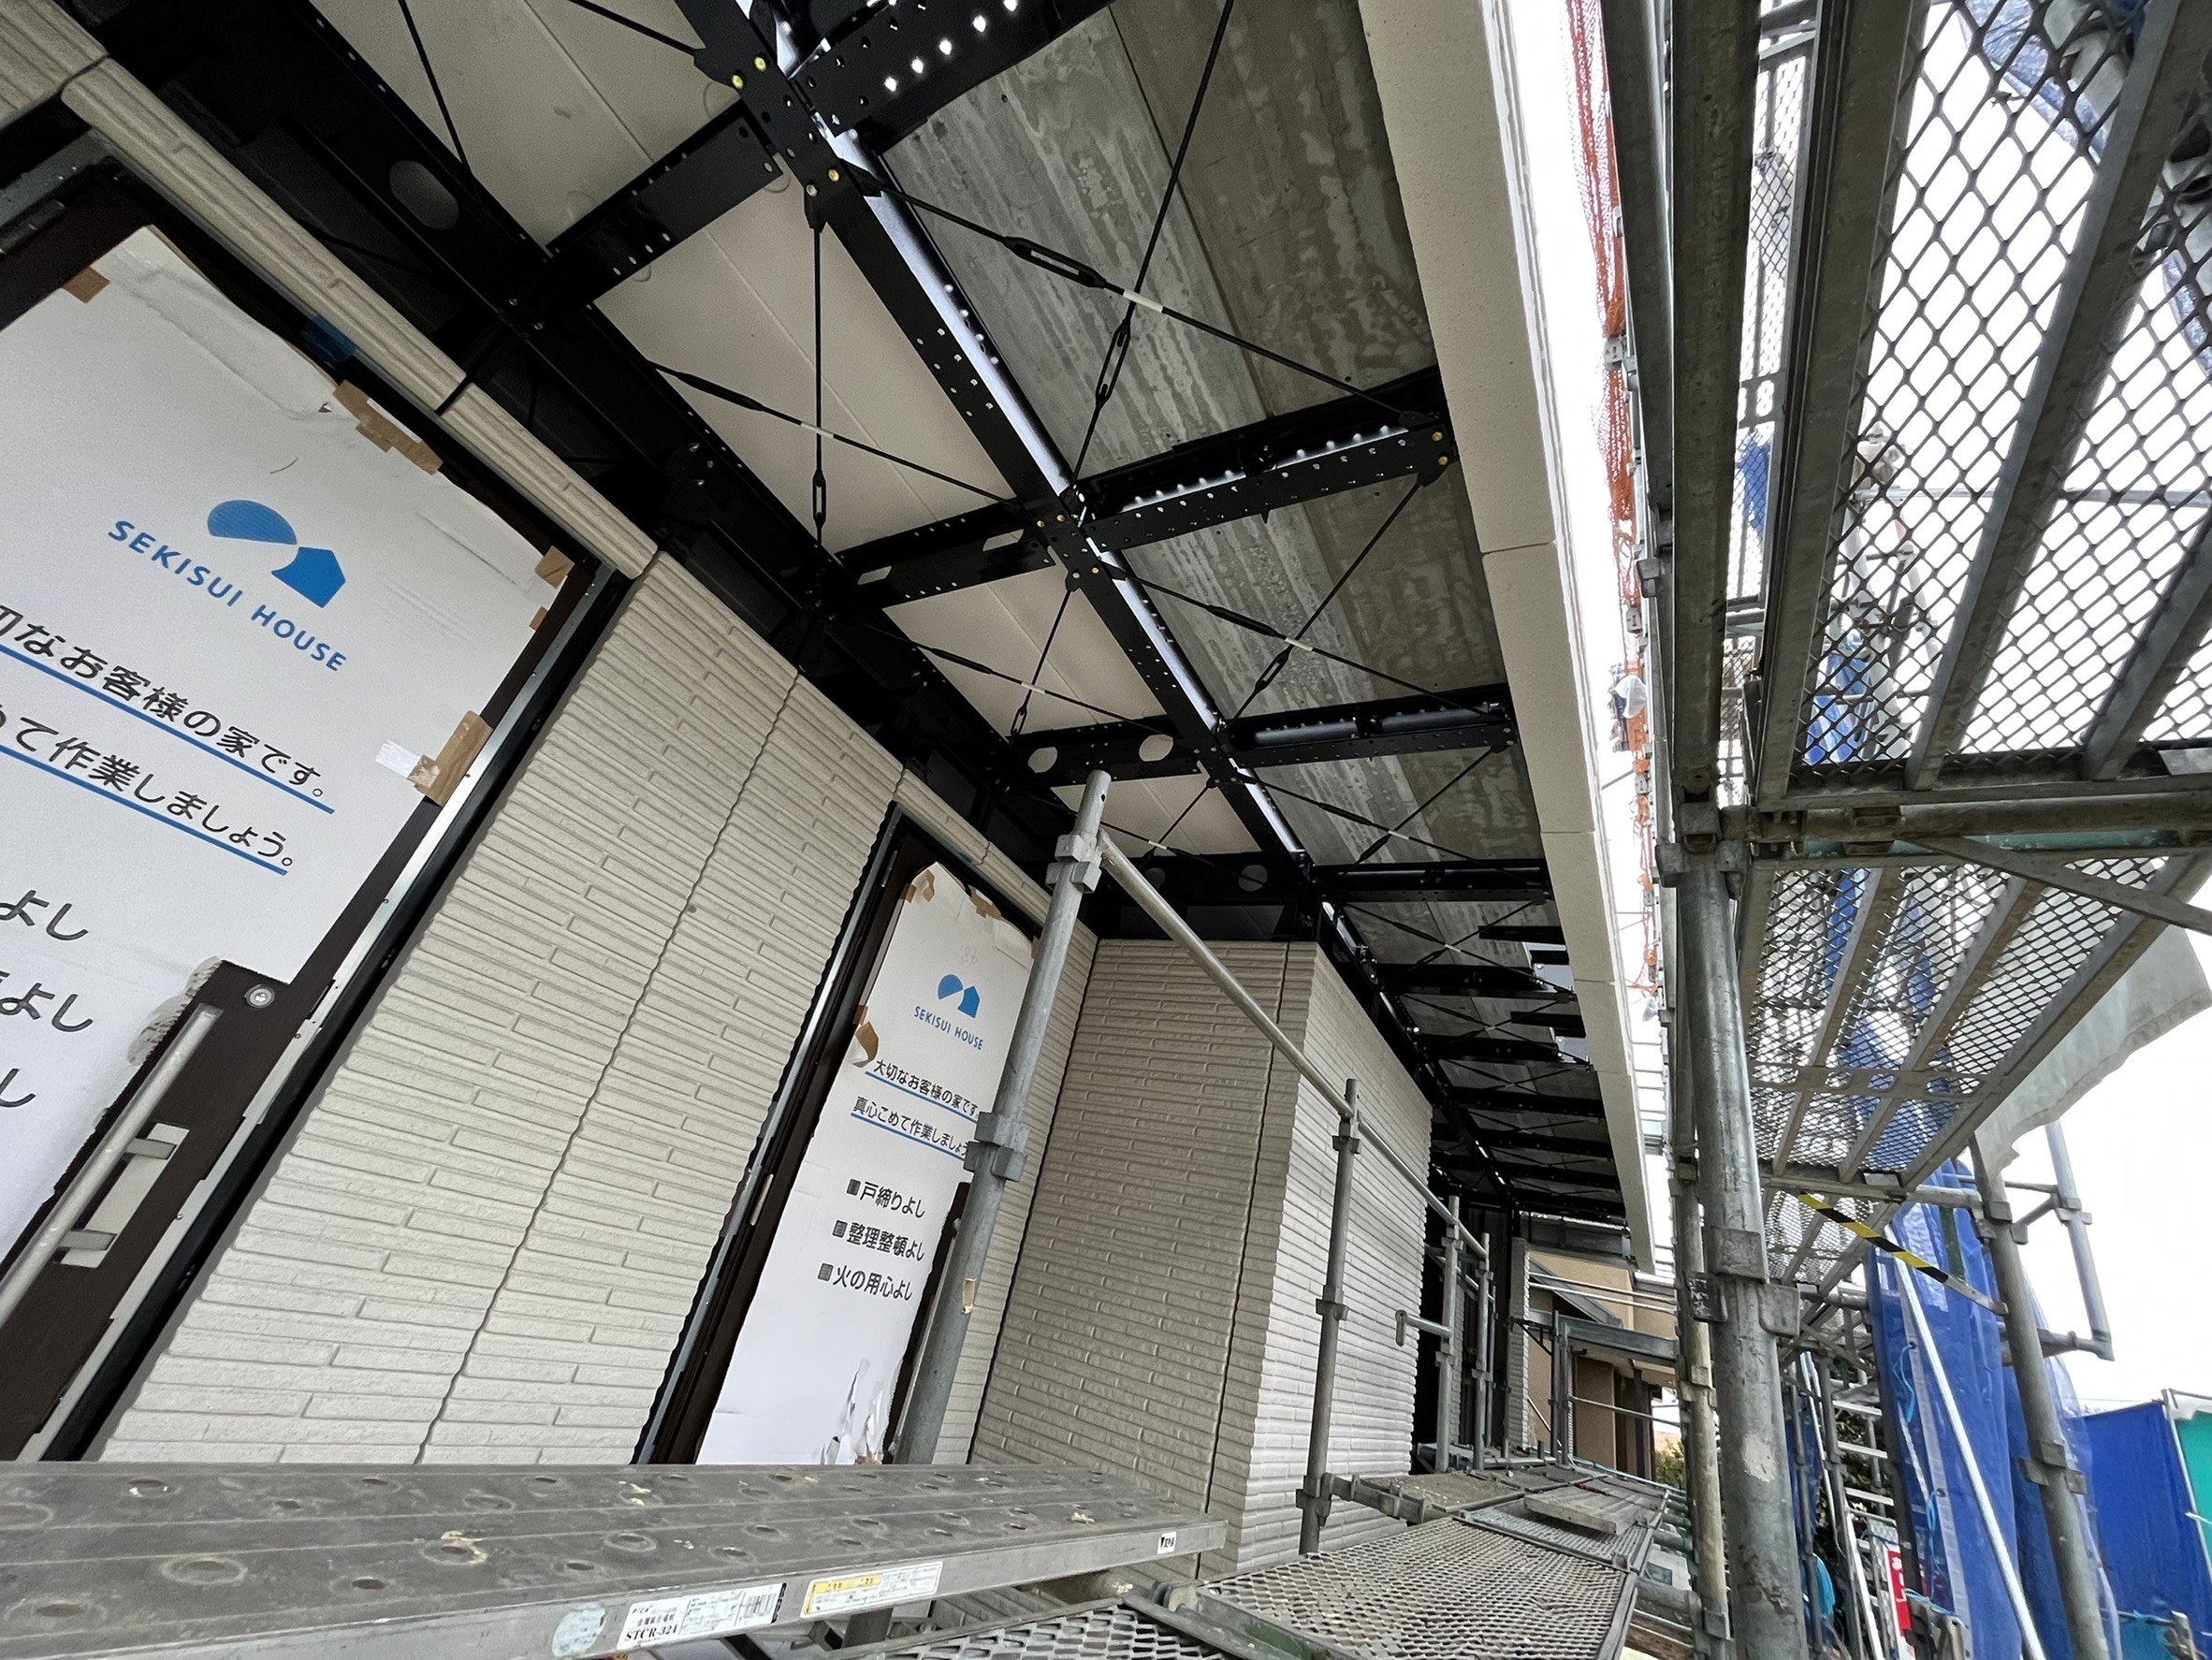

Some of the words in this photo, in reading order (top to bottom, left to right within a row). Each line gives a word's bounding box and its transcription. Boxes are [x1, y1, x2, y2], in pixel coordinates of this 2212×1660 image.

[108, 520, 243, 607] SEKISUI
[250, 604, 347, 671] HOUSE
[0, 604, 324, 798] なお客様の家です。
[913, 1006, 951, 1034] SEKISUI
[954, 1027, 983, 1050] HOUSE
[873, 1059, 979, 1119] 大切なお客様の家です。
